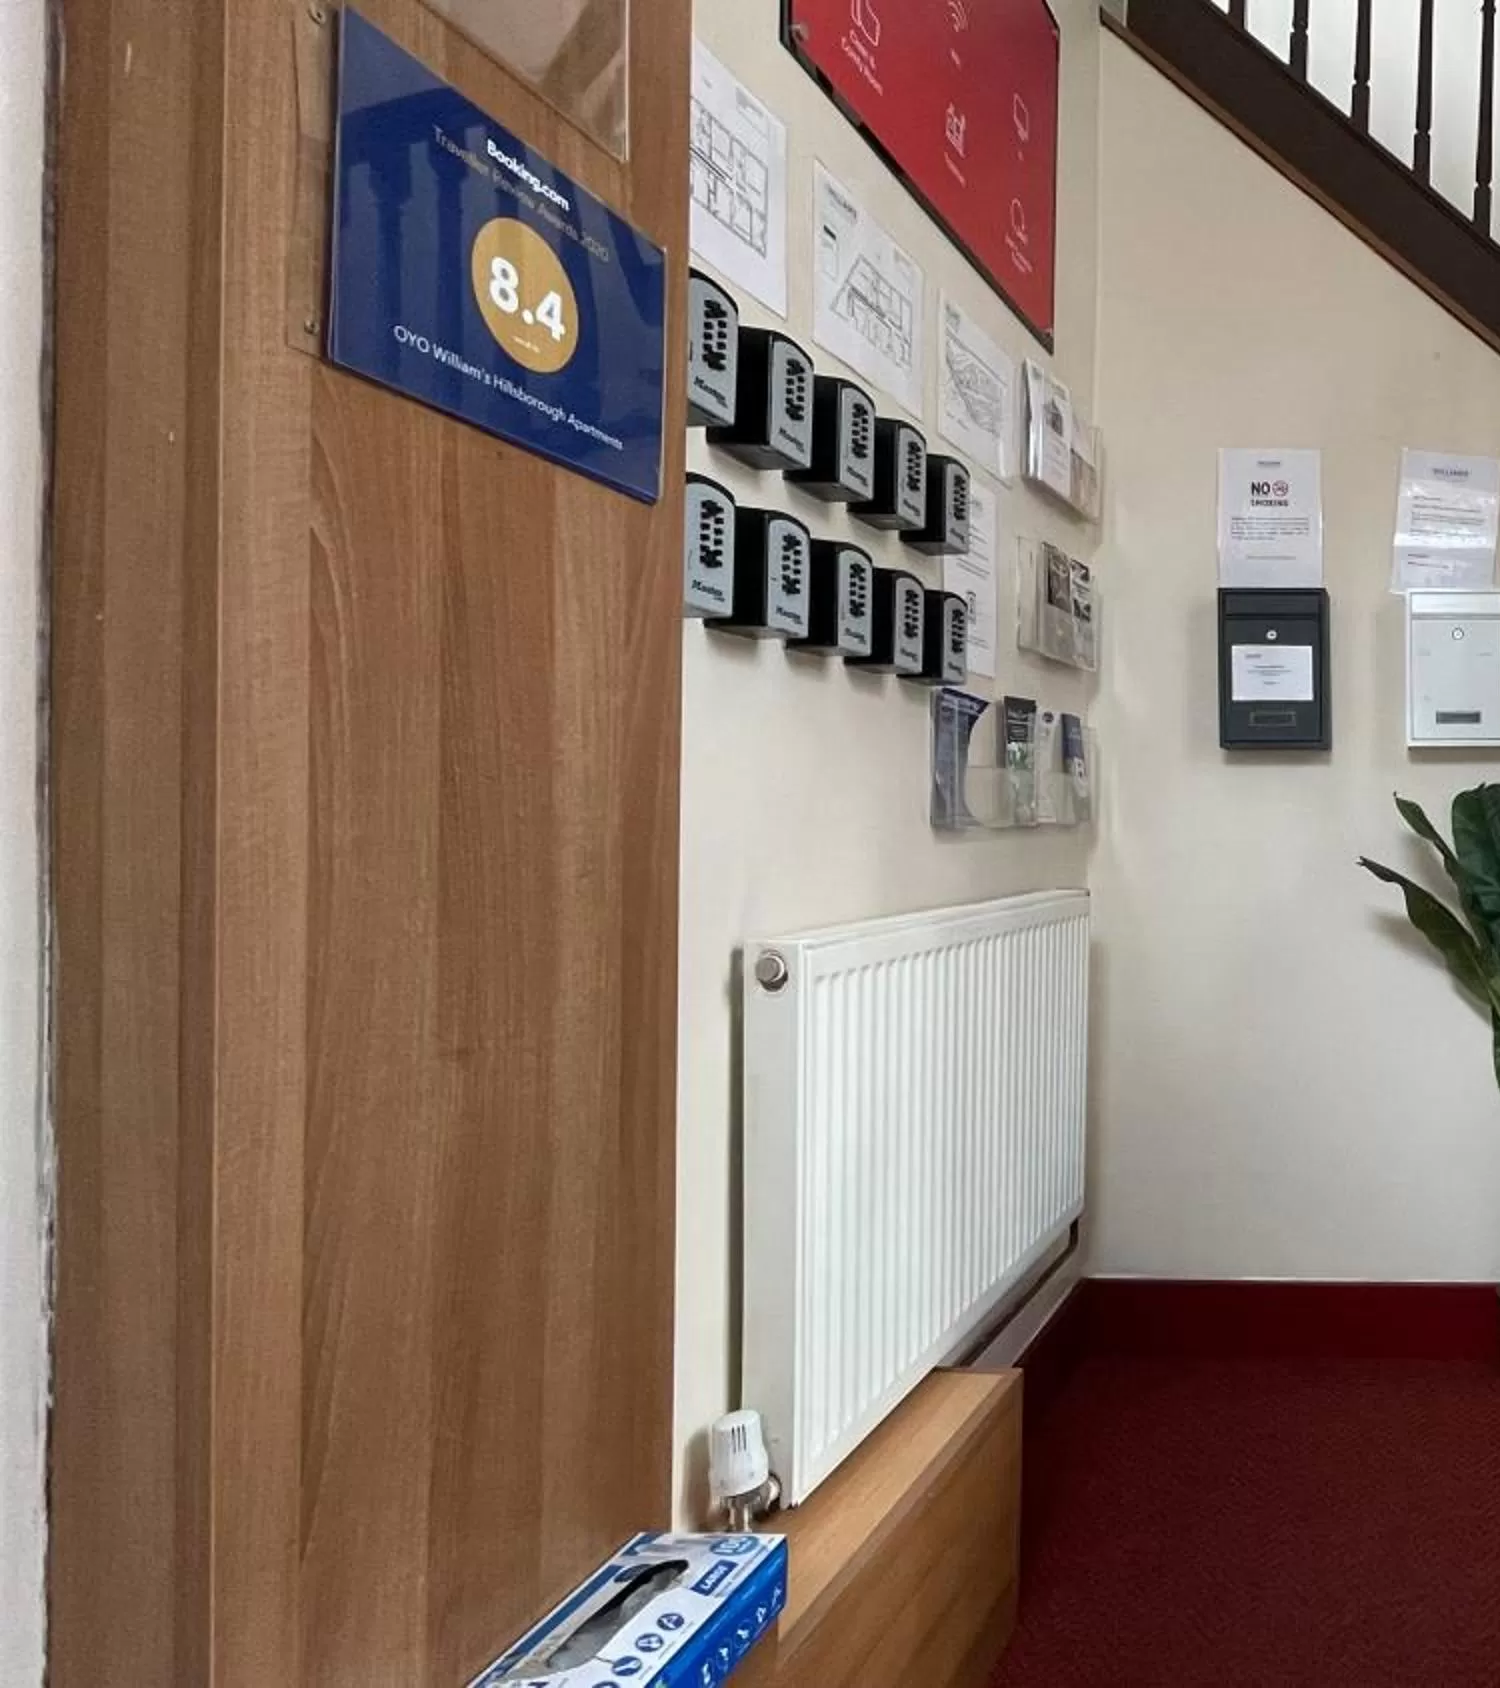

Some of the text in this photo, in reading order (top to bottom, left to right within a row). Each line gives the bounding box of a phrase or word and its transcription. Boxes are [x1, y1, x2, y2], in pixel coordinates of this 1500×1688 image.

[487, 138, 571, 212] Booking.com
[489, 257, 566, 341] 8.4
[394, 325, 430, 353] OYO
[432, 343, 491, 385] William's
[493, 373, 566, 421] Hillsborough
[566, 413, 624, 451] Apartments
[1251, 481, 1271, 496] NO
